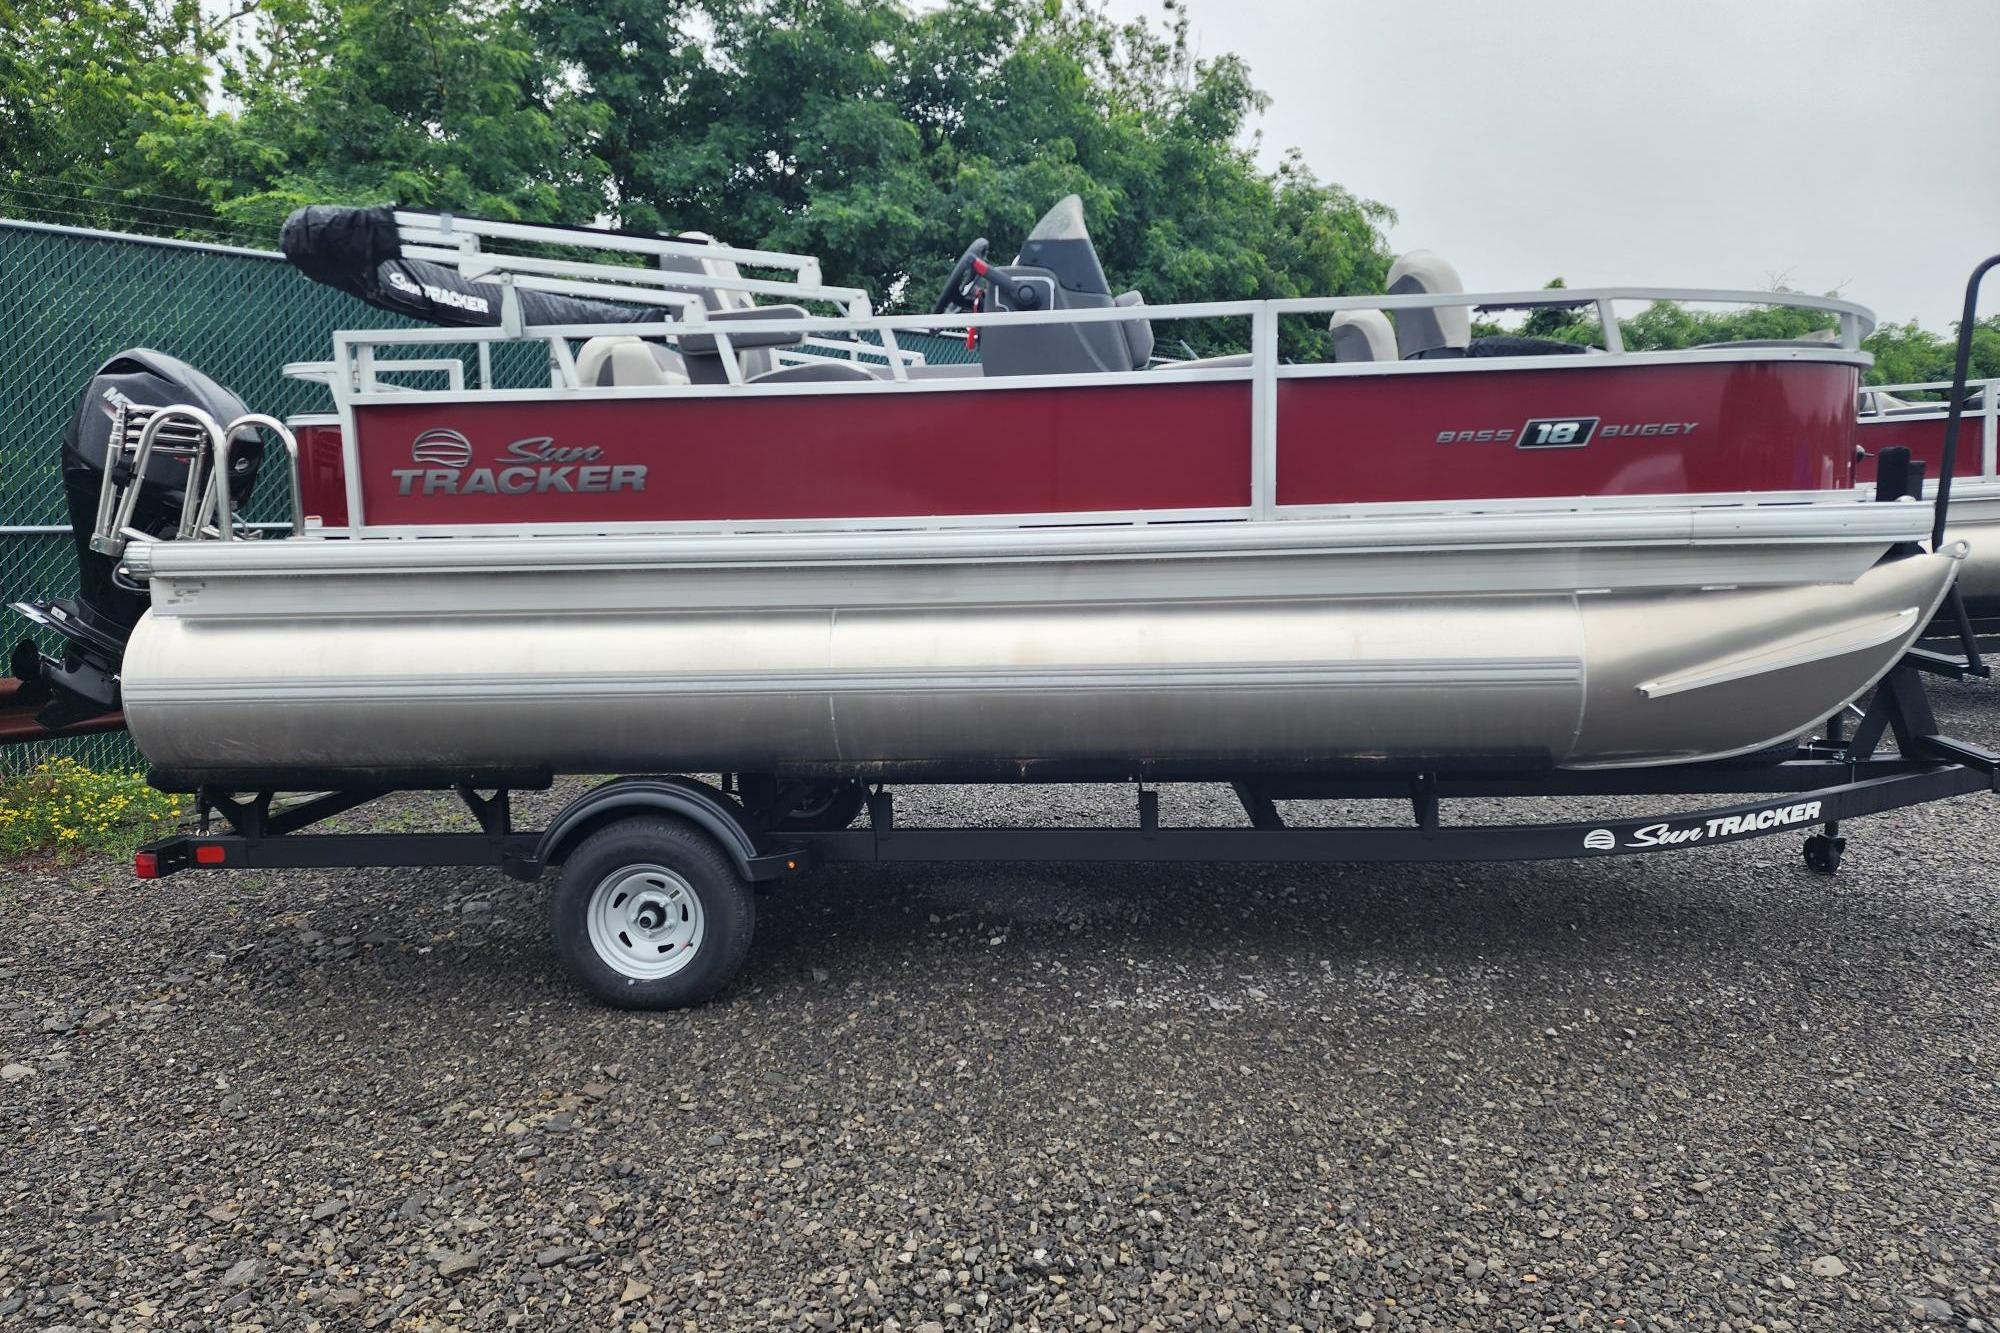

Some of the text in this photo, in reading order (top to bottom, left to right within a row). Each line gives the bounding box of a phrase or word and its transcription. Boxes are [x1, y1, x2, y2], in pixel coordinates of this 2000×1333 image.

[389, 272, 489, 314] Sun TRACKER
[1436, 422, 1699, 445] BASS 18 BUGGY
[496, 436, 605, 465] Sun
[391, 464, 648, 496] TRACKER
[1624, 800, 1822, 848] Sun TRACKER
